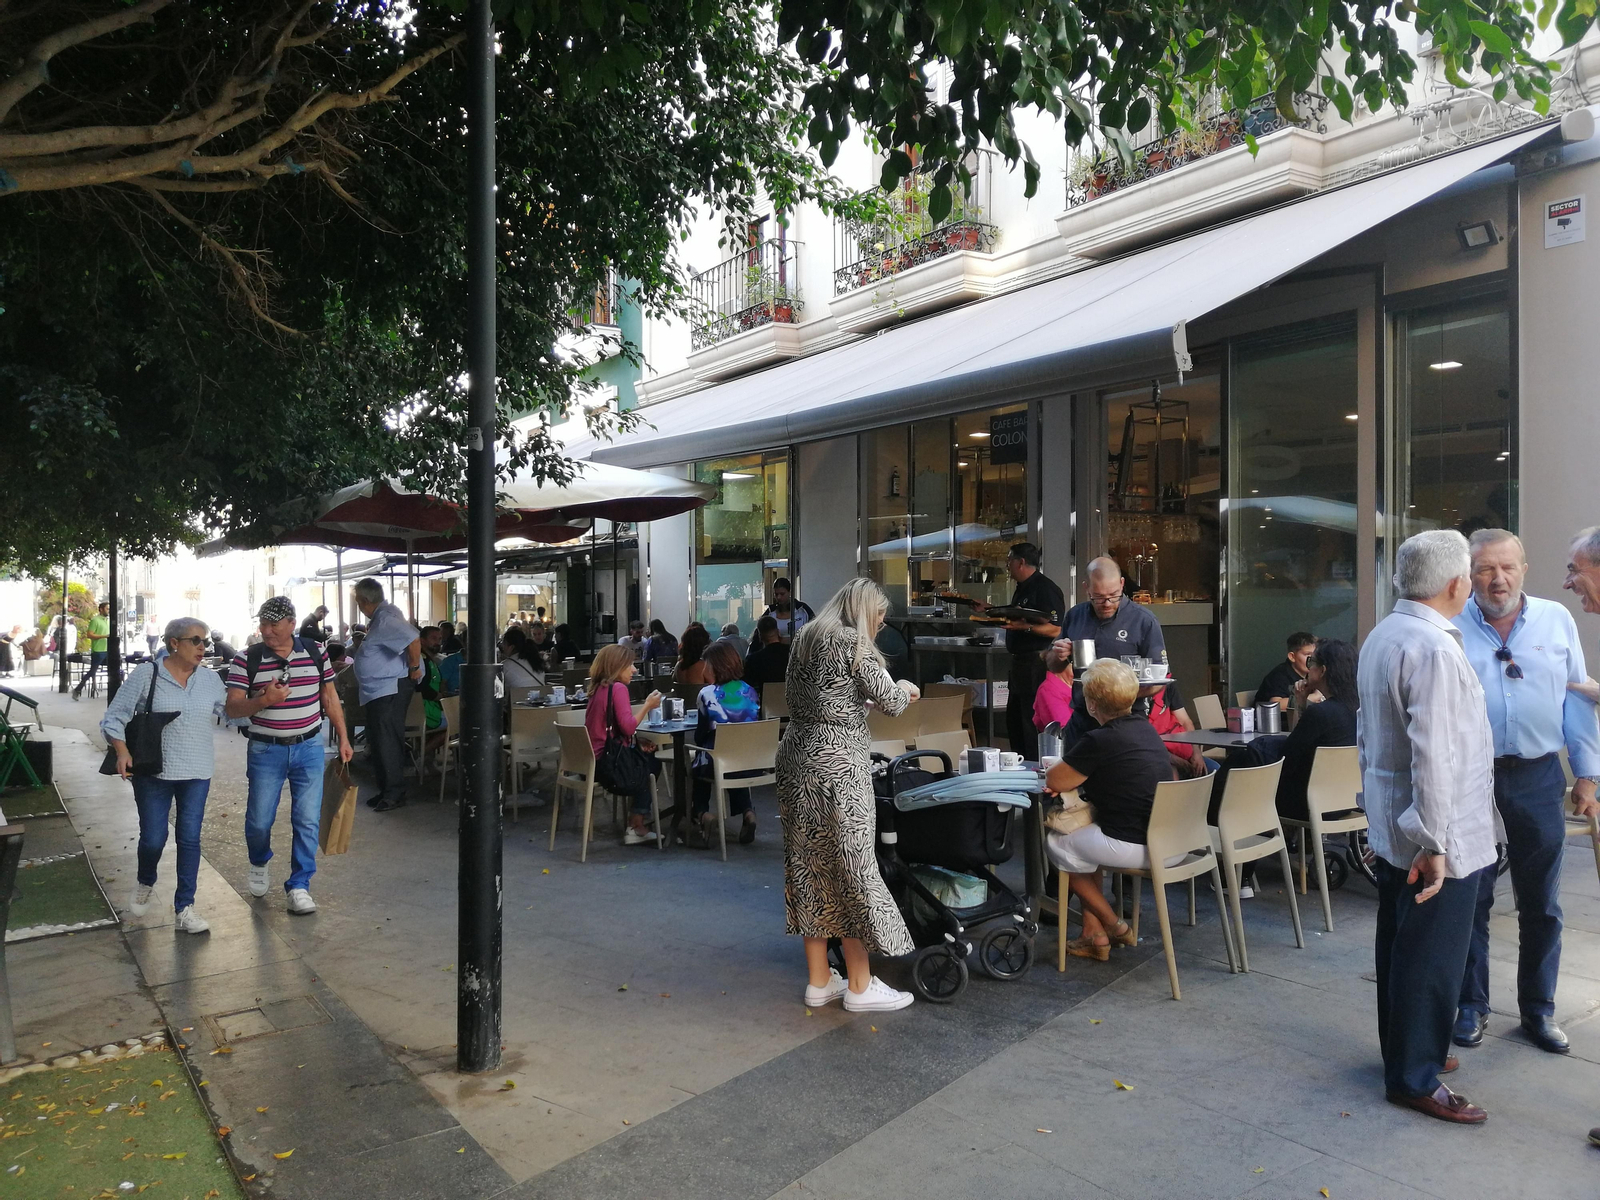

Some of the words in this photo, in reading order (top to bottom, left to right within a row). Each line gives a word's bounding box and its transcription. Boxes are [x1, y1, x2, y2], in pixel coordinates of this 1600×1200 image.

[1550, 200, 1579, 212] SECTOR
[992, 418, 1011, 431] CAFE
[991, 430, 1028, 448] COLON
